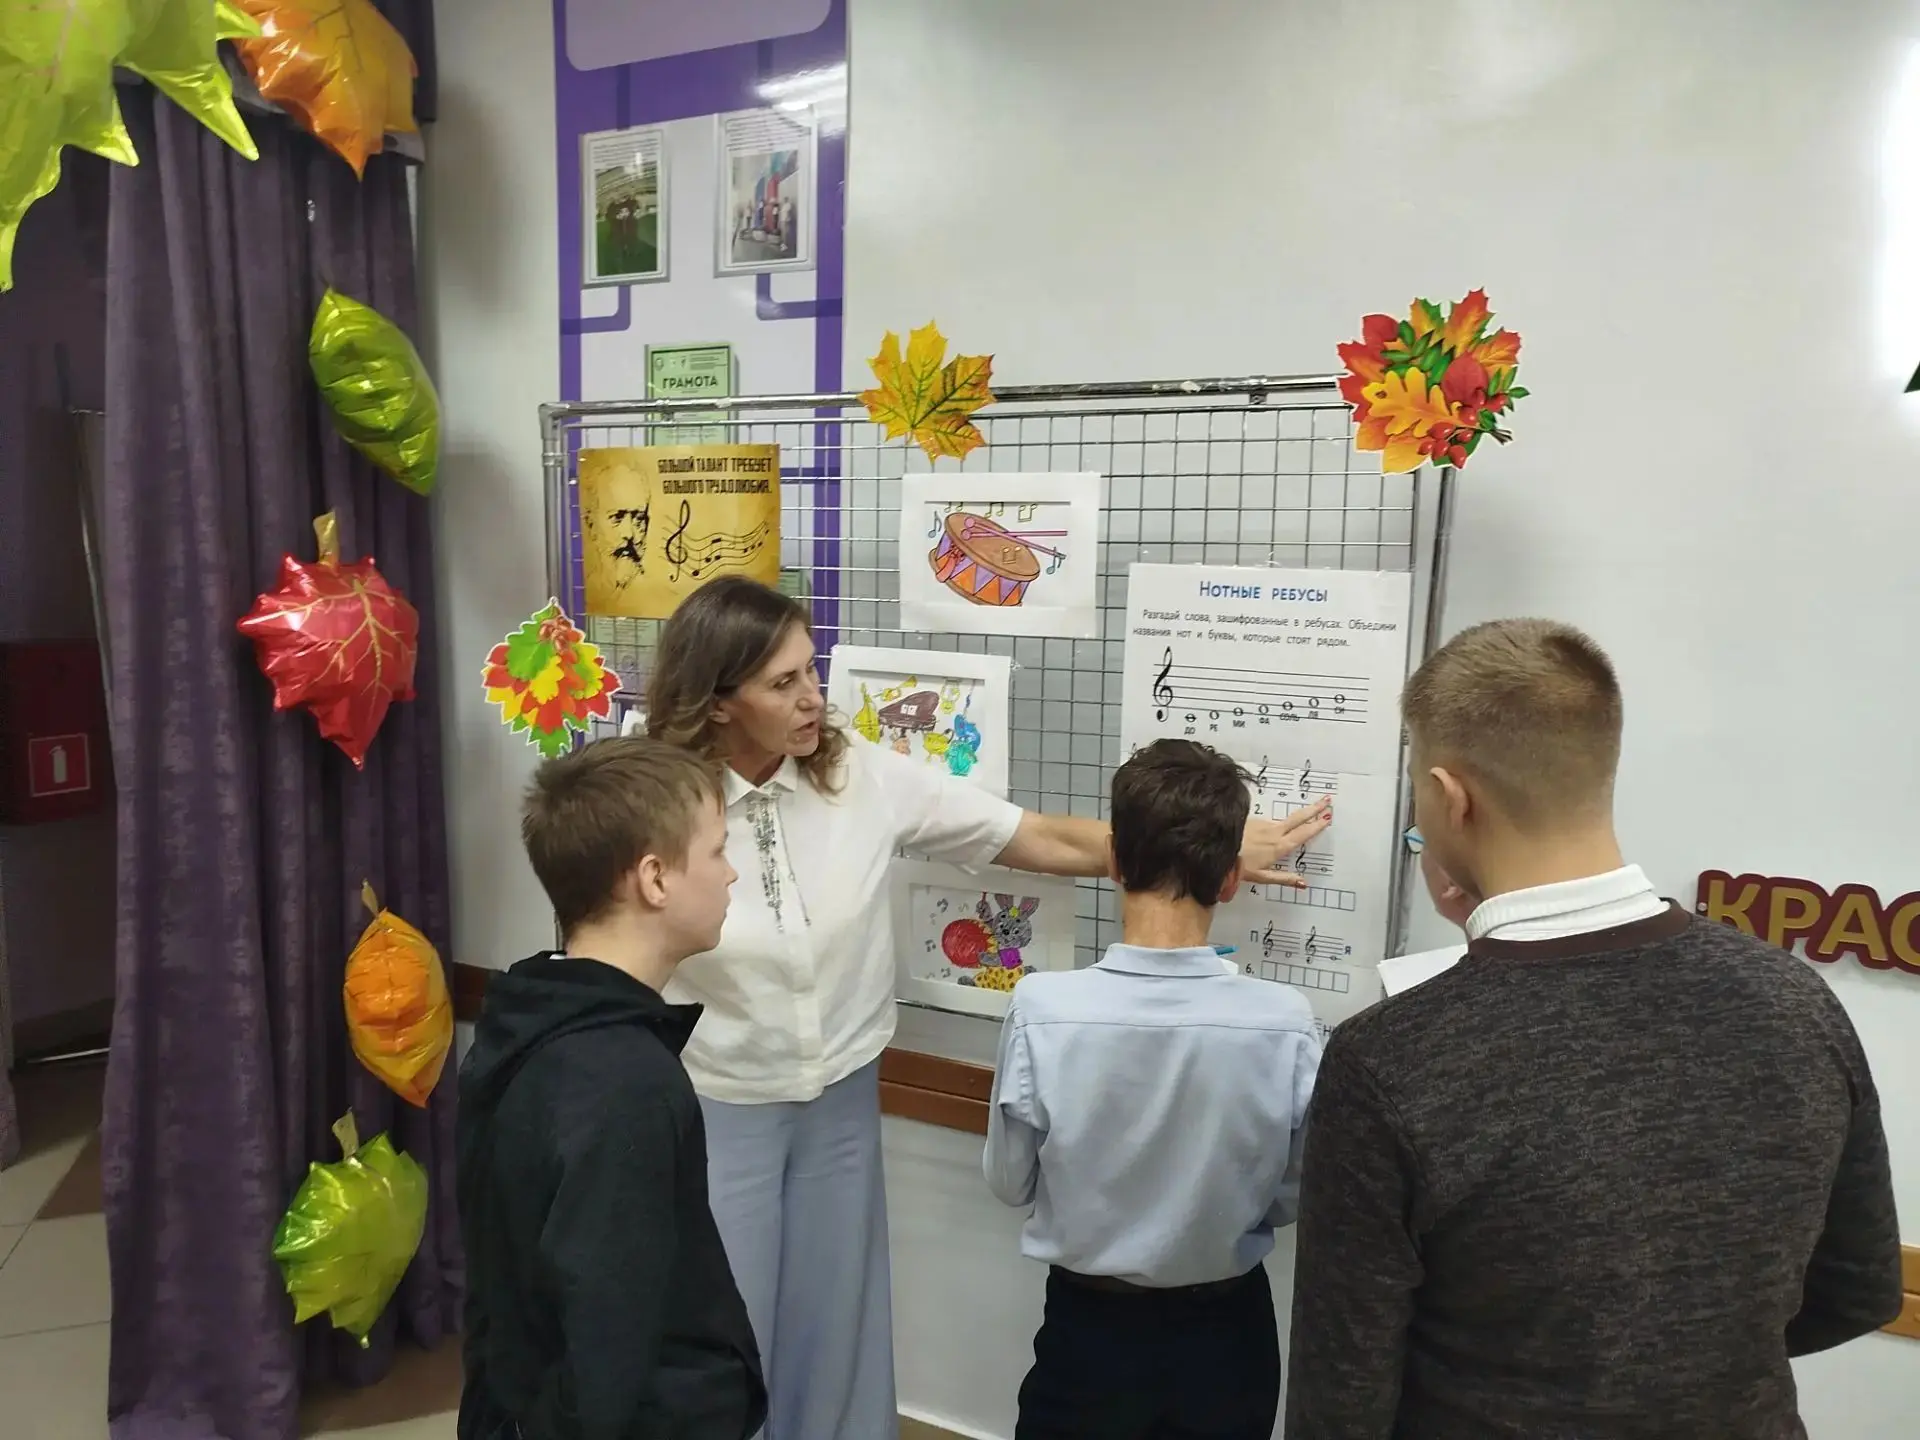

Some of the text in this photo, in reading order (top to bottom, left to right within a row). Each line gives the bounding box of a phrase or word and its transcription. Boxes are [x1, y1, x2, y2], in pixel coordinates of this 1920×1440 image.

[662, 375, 718, 389] ГРАМОТА
[658, 456, 772, 473] БОЛЬШОЙ ТАЛАНТ ТРЕБУЕТ
[663, 480, 704, 494] БОЛЬШОГО
[1271, 587, 1328, 602] РЕБУСЫ
[1143, 609, 1180, 622] Разгадай
[1184, 612, 1211, 624] слова,
[1217, 613, 1289, 627] зашифрованные
[1304, 617, 1343, 630] ребусах.
[1348, 618, 1397, 631] Объедини
[1133, 627, 1171, 636] названия
[1177, 630, 1192, 638] нот
[1208, 628, 1237, 642] буквы,
[1243, 633, 1281, 644] которые
[1286, 636, 1311, 645] стоят
[1316, 637, 1350, 648] рядом.
[1184, 726, 1196, 735] ДО
[1209, 723, 1218, 732] РЕ
[1233, 720, 1246, 728] МИ
[1259, 717, 1270, 725] ФА
[1279, 713, 1300, 722] СОЛЬ
